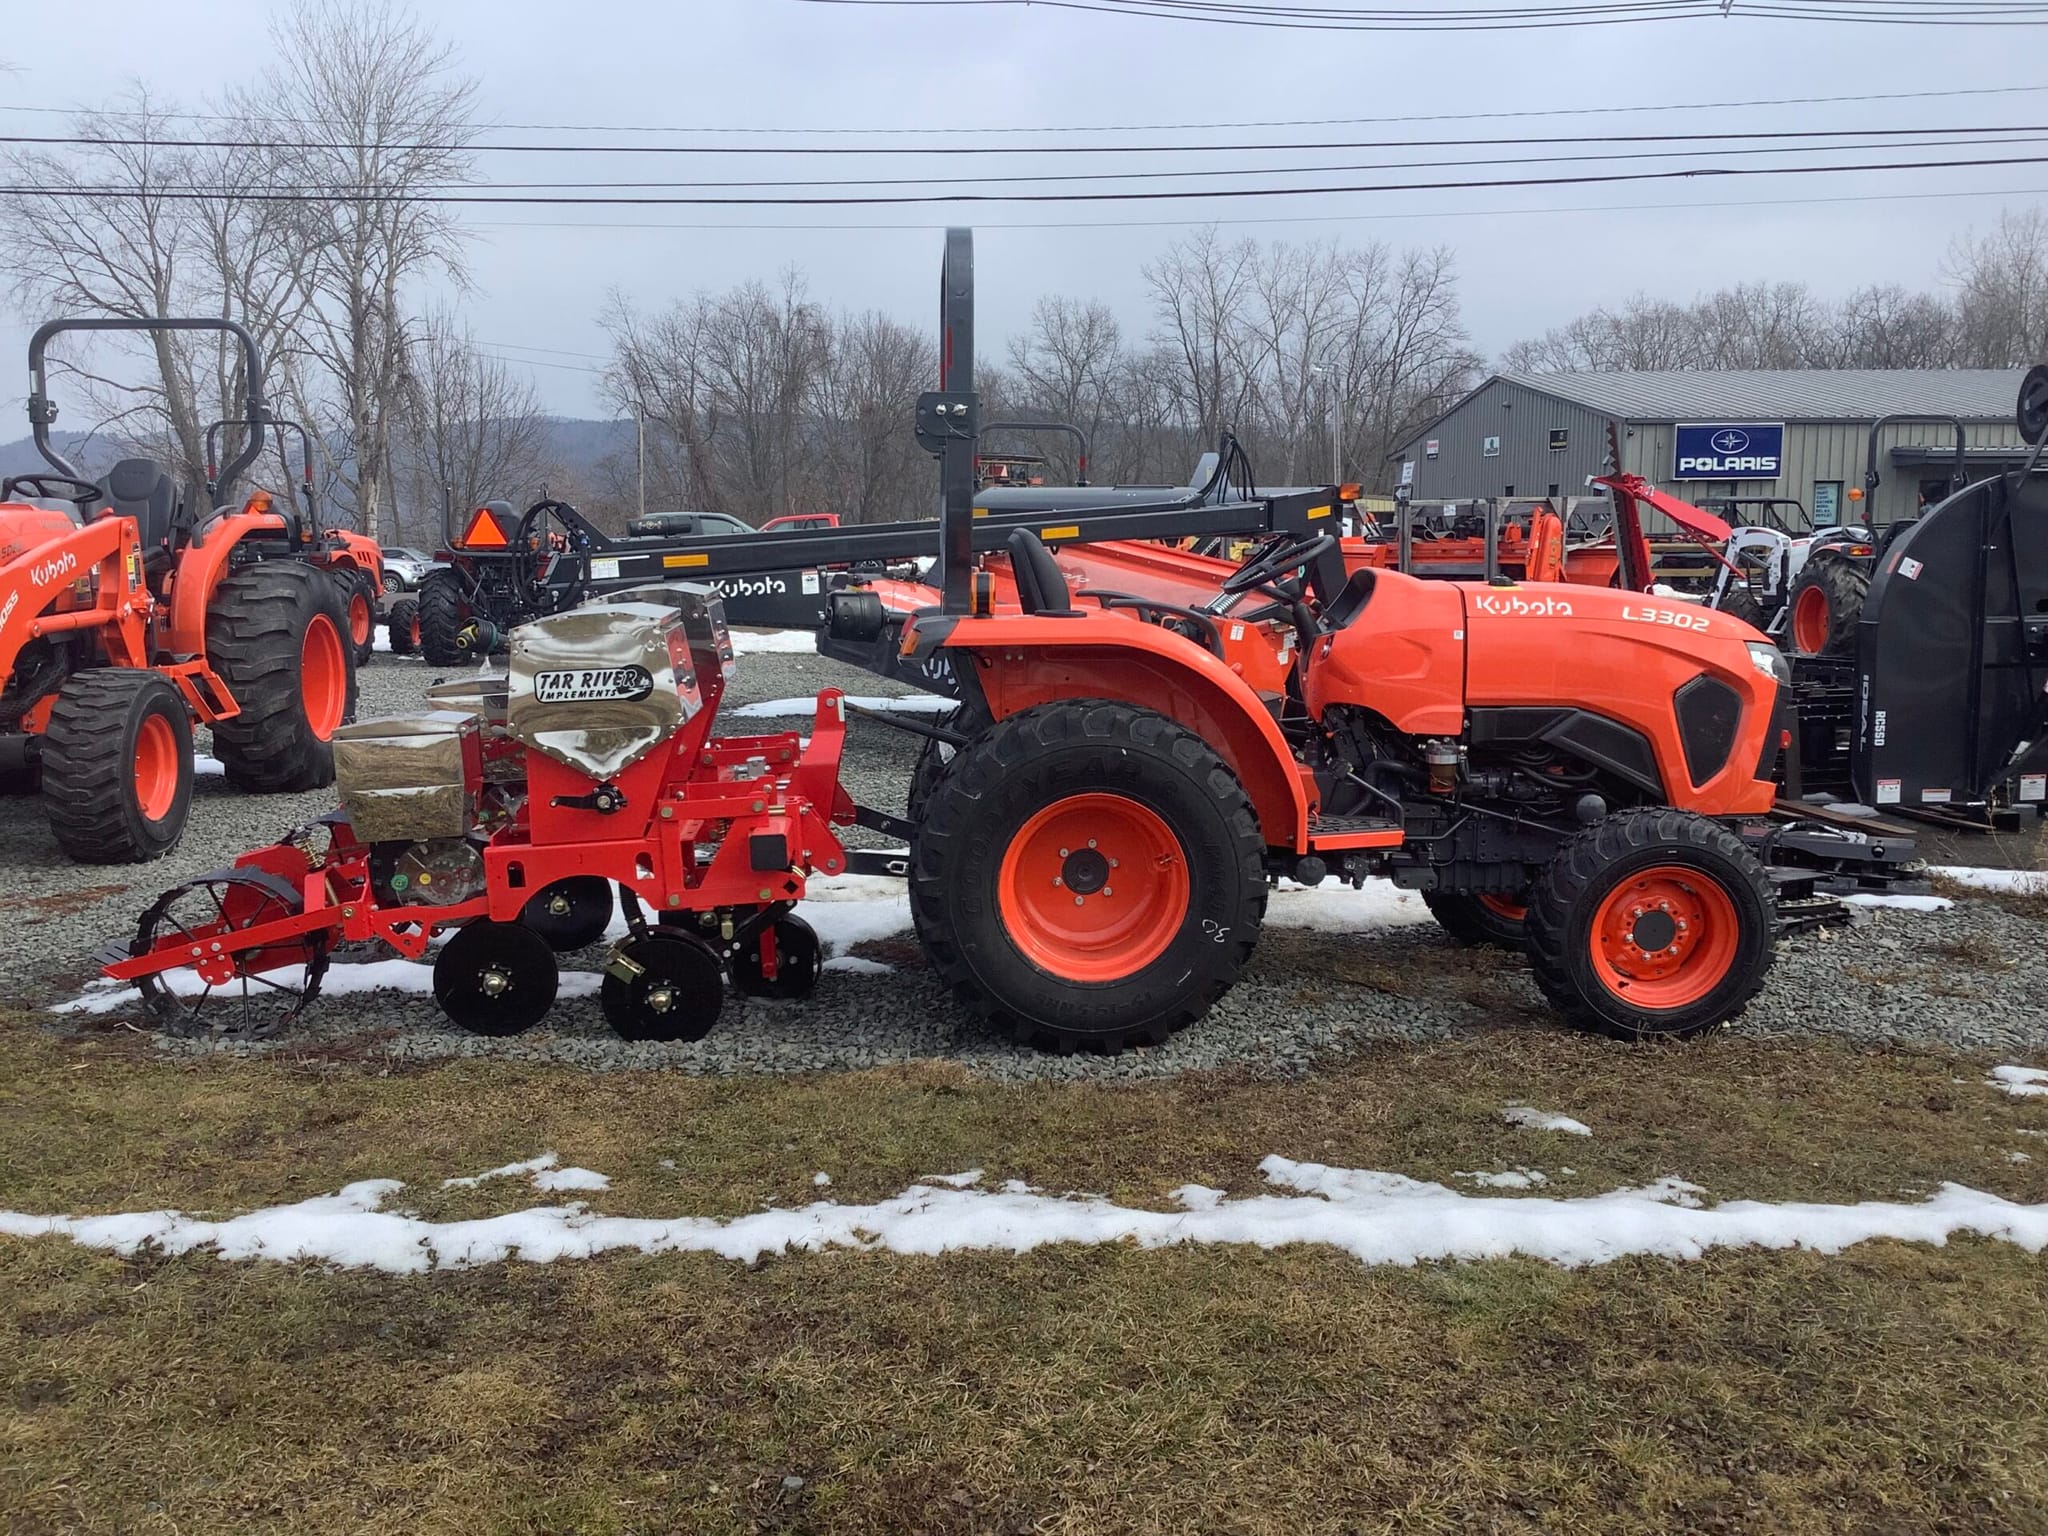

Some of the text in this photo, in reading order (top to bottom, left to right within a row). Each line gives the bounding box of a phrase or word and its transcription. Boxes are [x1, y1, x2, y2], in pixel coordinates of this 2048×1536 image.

[1680, 457, 1777, 471] POLARIS
[30, 551, 77, 588] Kubota
[710, 575, 786, 598] Kubota
[1476, 595, 1573, 616] Kubota
[1622, 606, 1710, 633] L3302
[540, 669, 638, 690] TAR RIVER
[540, 688, 617, 700] IMPLEMENTS
[1860, 675, 1870, 752] IDEAL
